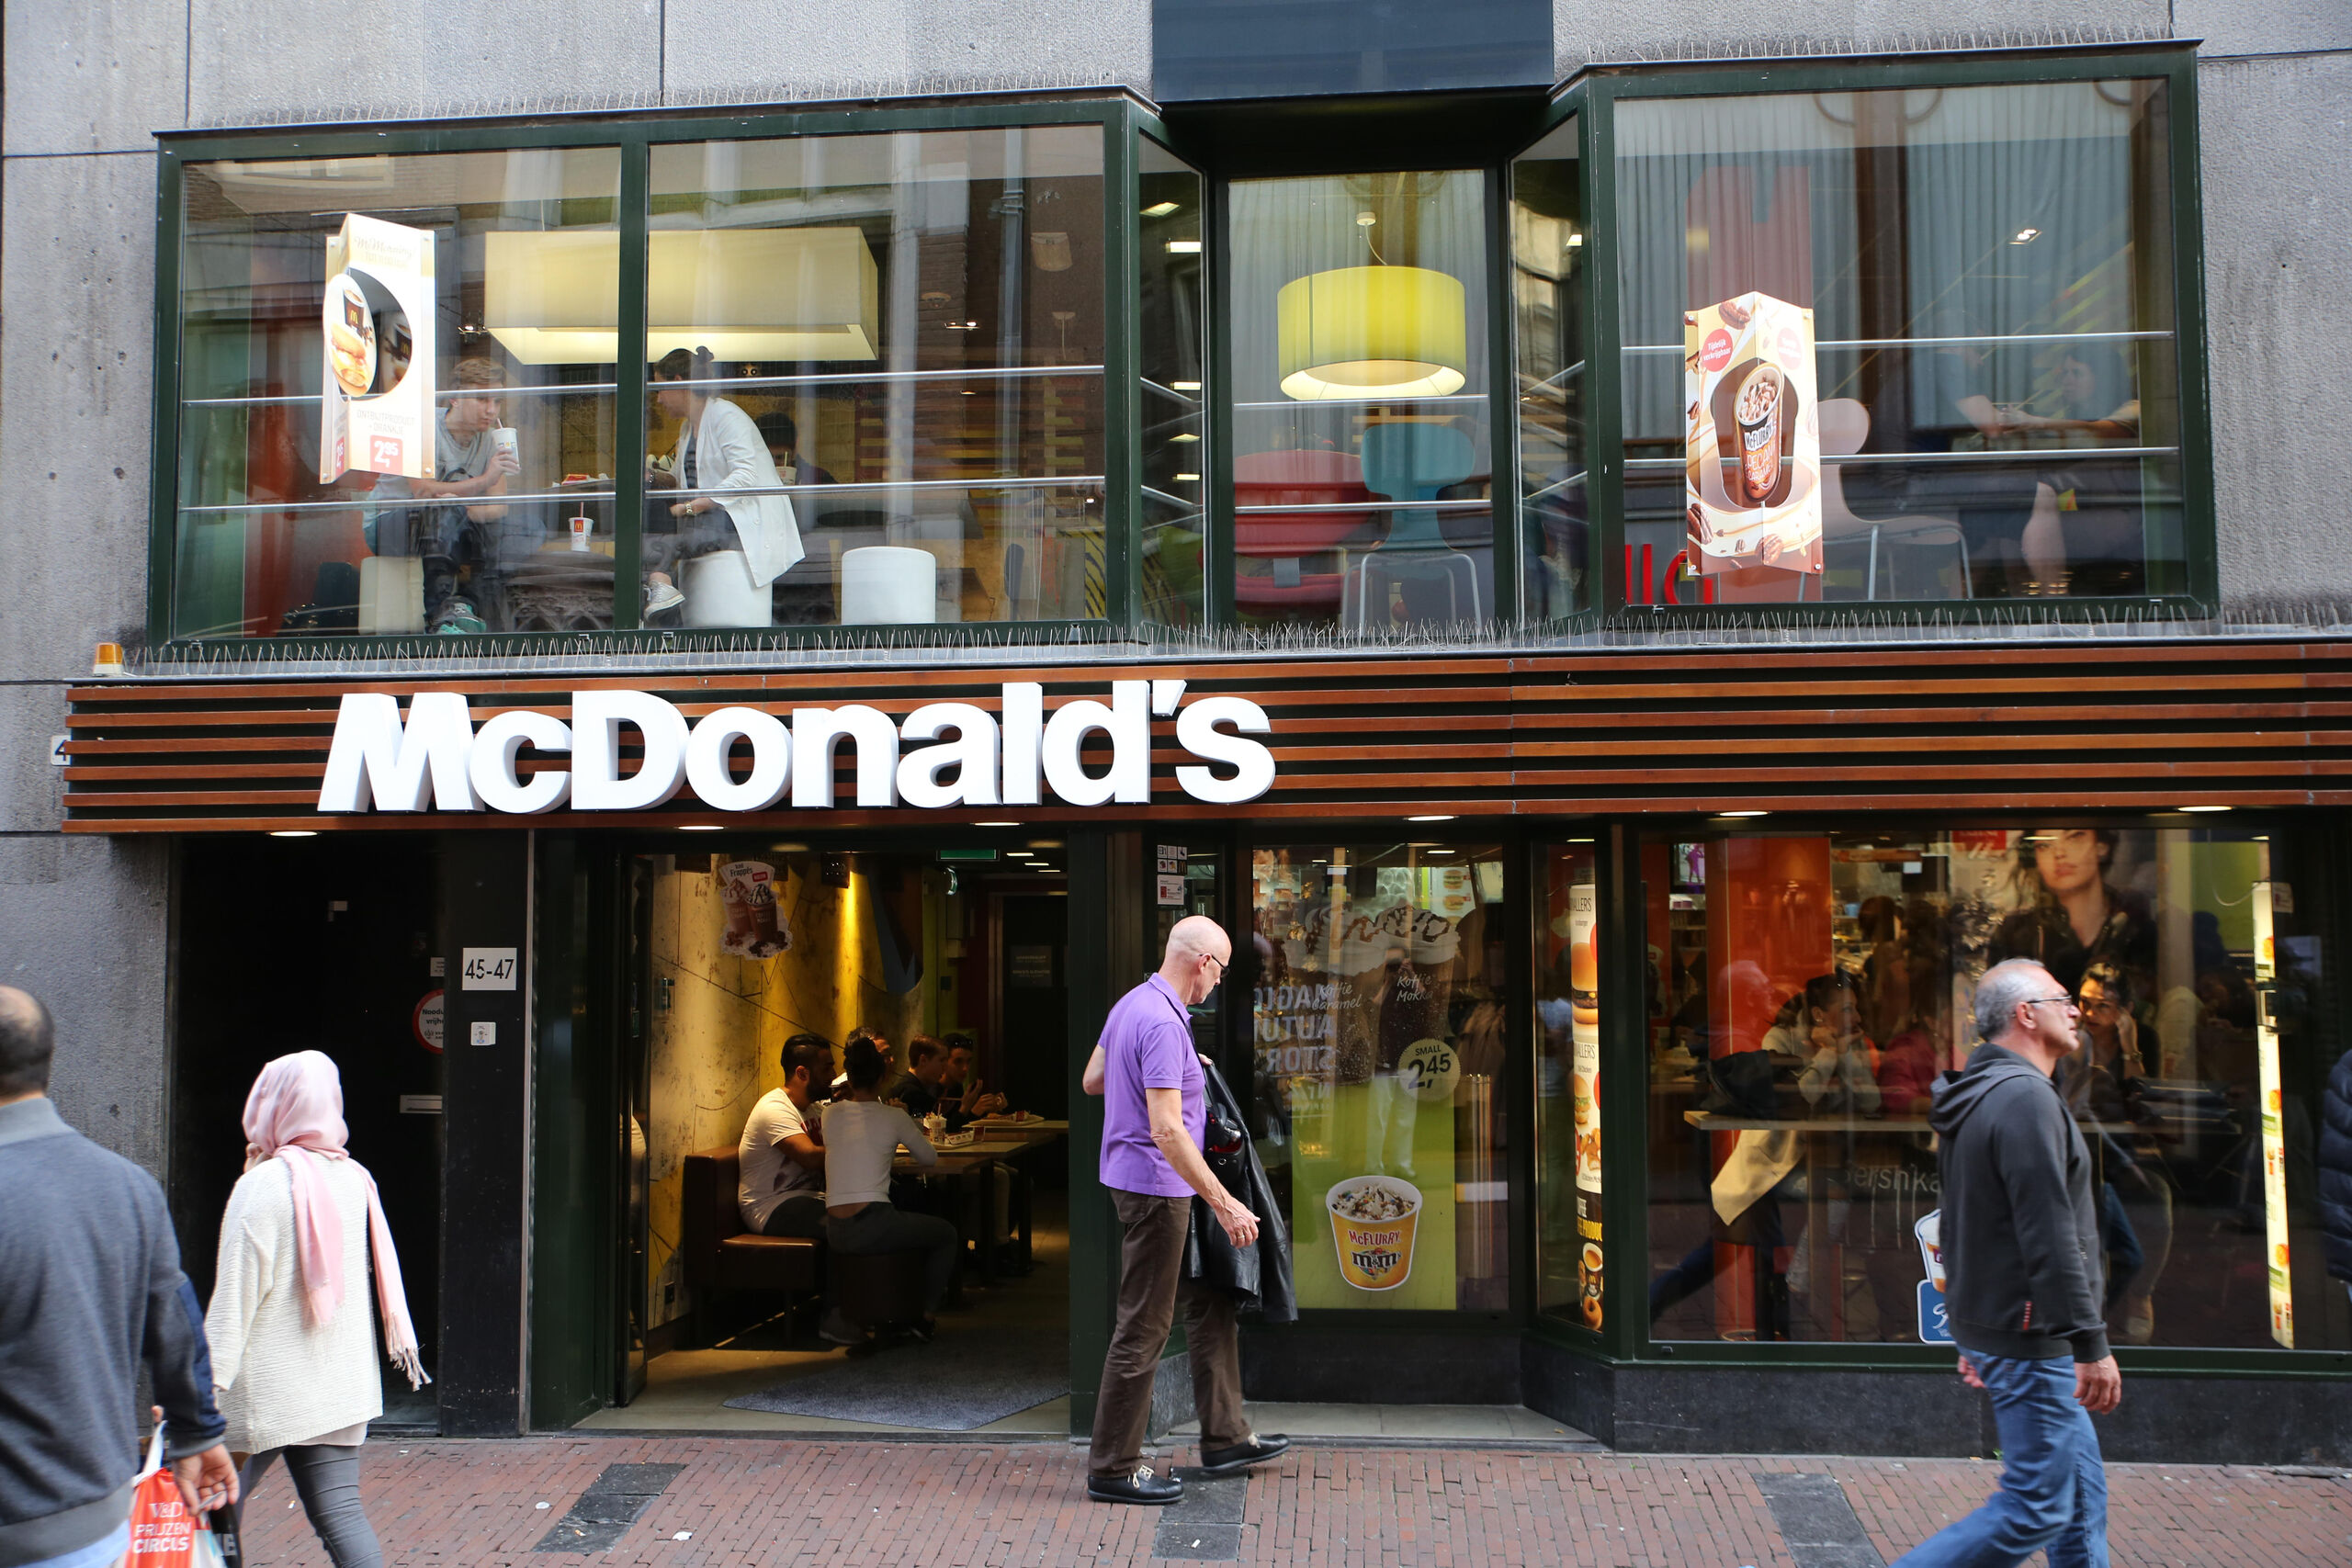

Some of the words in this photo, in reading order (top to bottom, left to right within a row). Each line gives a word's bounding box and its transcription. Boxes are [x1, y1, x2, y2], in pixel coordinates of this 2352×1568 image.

[316, 680, 1276, 815] McDonald's
[464, 958, 514, 980] 45-47
[1312, 993, 1363, 1011] Caramel
[1415, 1043, 1442, 1056] SMALL
[1348, 1229, 1400, 1247] McFLURRY
